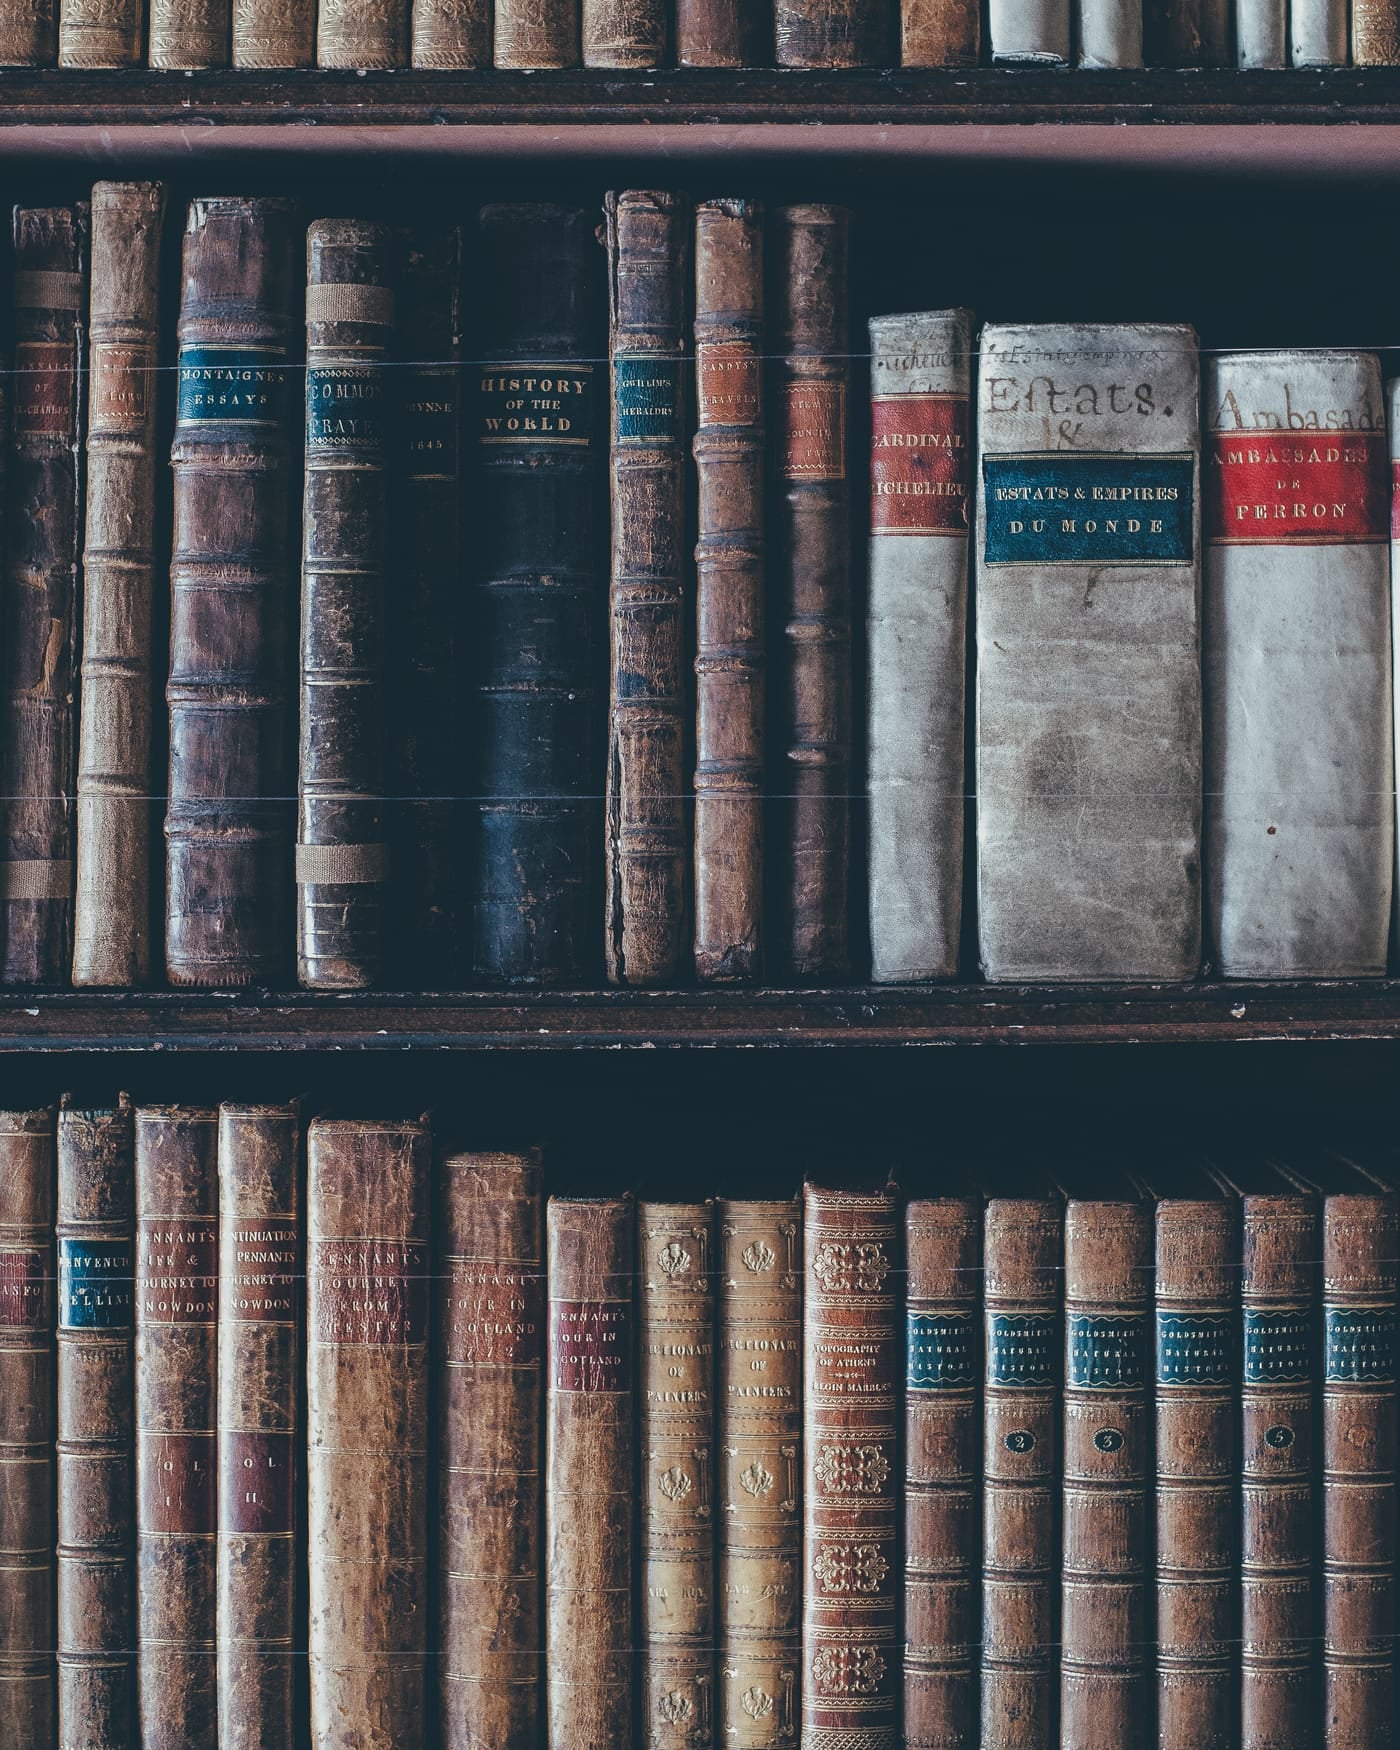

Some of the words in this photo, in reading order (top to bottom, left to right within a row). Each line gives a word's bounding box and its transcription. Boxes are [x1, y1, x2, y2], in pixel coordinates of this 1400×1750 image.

[181, 369, 285, 383] MONTAIGNES
[481, 378, 587, 394] HISTORY
[194, 394, 267, 405] ESSAYS
[505, 400, 523, 410] OF
[531, 399, 561, 410] THE
[703, 394, 756, 406] TRAVELS
[622, 407, 673, 416] HERALDRY
[485, 417, 571, 431] WORLD
[872, 434, 965, 448] CARDINAL
[1211, 447, 1368, 466] AMBASSADES
[1276, 479, 1300, 489] DE
[995, 487, 1069, 501] ESTATS
[1074, 488, 1086, 499] &
[1092, 487, 1178, 501] EMPIRES
[1236, 503, 1346, 520] PERRON
[1009, 519, 1045, 533] DU
[1062, 519, 1163, 533] MONDE
[137, 1255, 174, 1266] LIFE
[187, 1254, 198, 1266] &
[237, 1251, 295, 1263] PENNANTS
[136, 1278, 195, 1289] JOURNEY
[203, 1278, 216, 1288] TO
[281, 1275, 293, 1285] TO
[136, 1301, 215, 1313] SNOWDON
[341, 1301, 389, 1311] FROM
[510, 1300, 525, 1311] IN
[603, 1332, 616, 1342] IN
[813, 1344, 880, 1354] TOPOGRAPHY
[1332, 1345, 1390, 1353] NATURL
[750, 1360, 767, 1371] OF
[819, 1359, 833, 1367] OF
[836, 1358, 876, 1367] ATHENS
[668, 1366, 684, 1377] OF
[647, 1390, 708, 1402] PAINTERS
[727, 1385, 791, 1397] PAINTERS
[1015, 1435, 1025, 1449] 2
[1102, 1435, 1112, 1447] 3
[1274, 1430, 1284, 1443] 5
